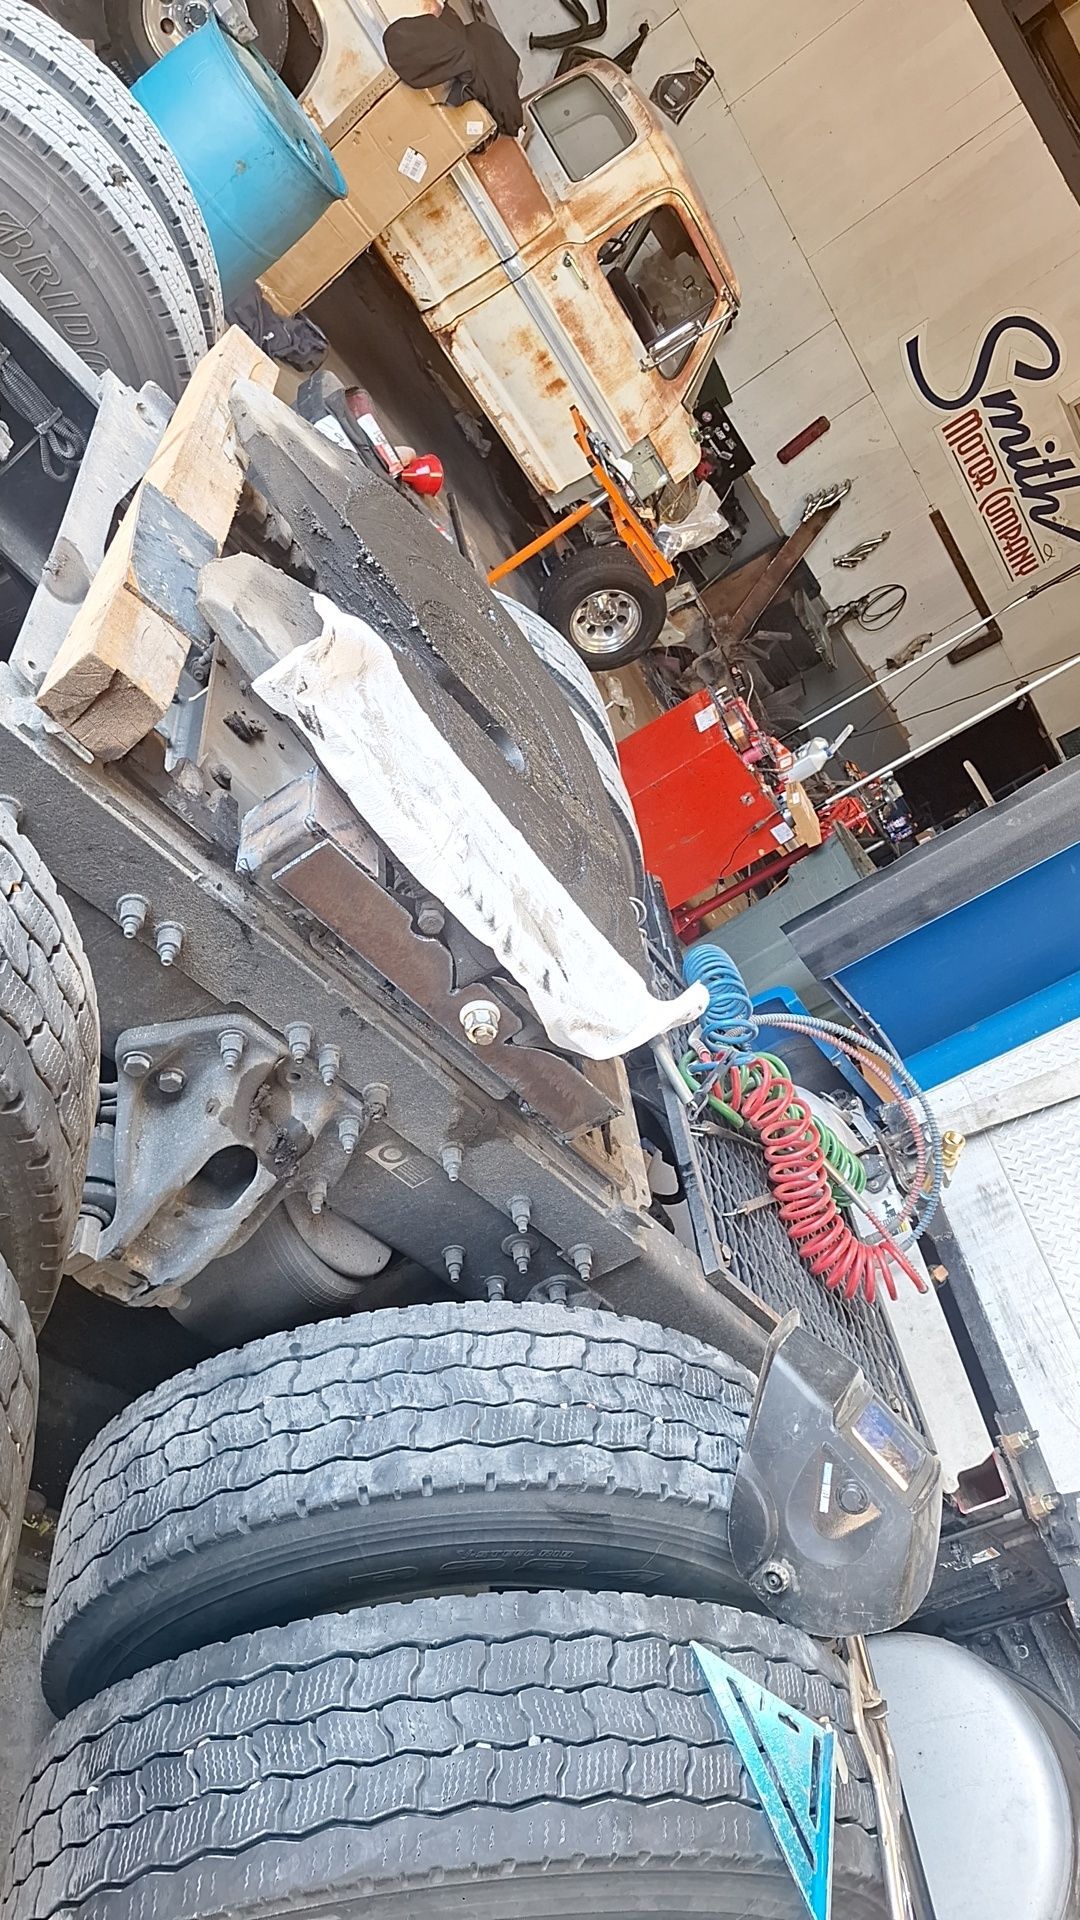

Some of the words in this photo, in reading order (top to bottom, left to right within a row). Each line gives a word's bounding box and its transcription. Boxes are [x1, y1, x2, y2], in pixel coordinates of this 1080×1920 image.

[906, 316, 1080, 542] Smith
[942, 408, 997, 492] MOTOR
[978, 487, 1039, 577] COMPANY
